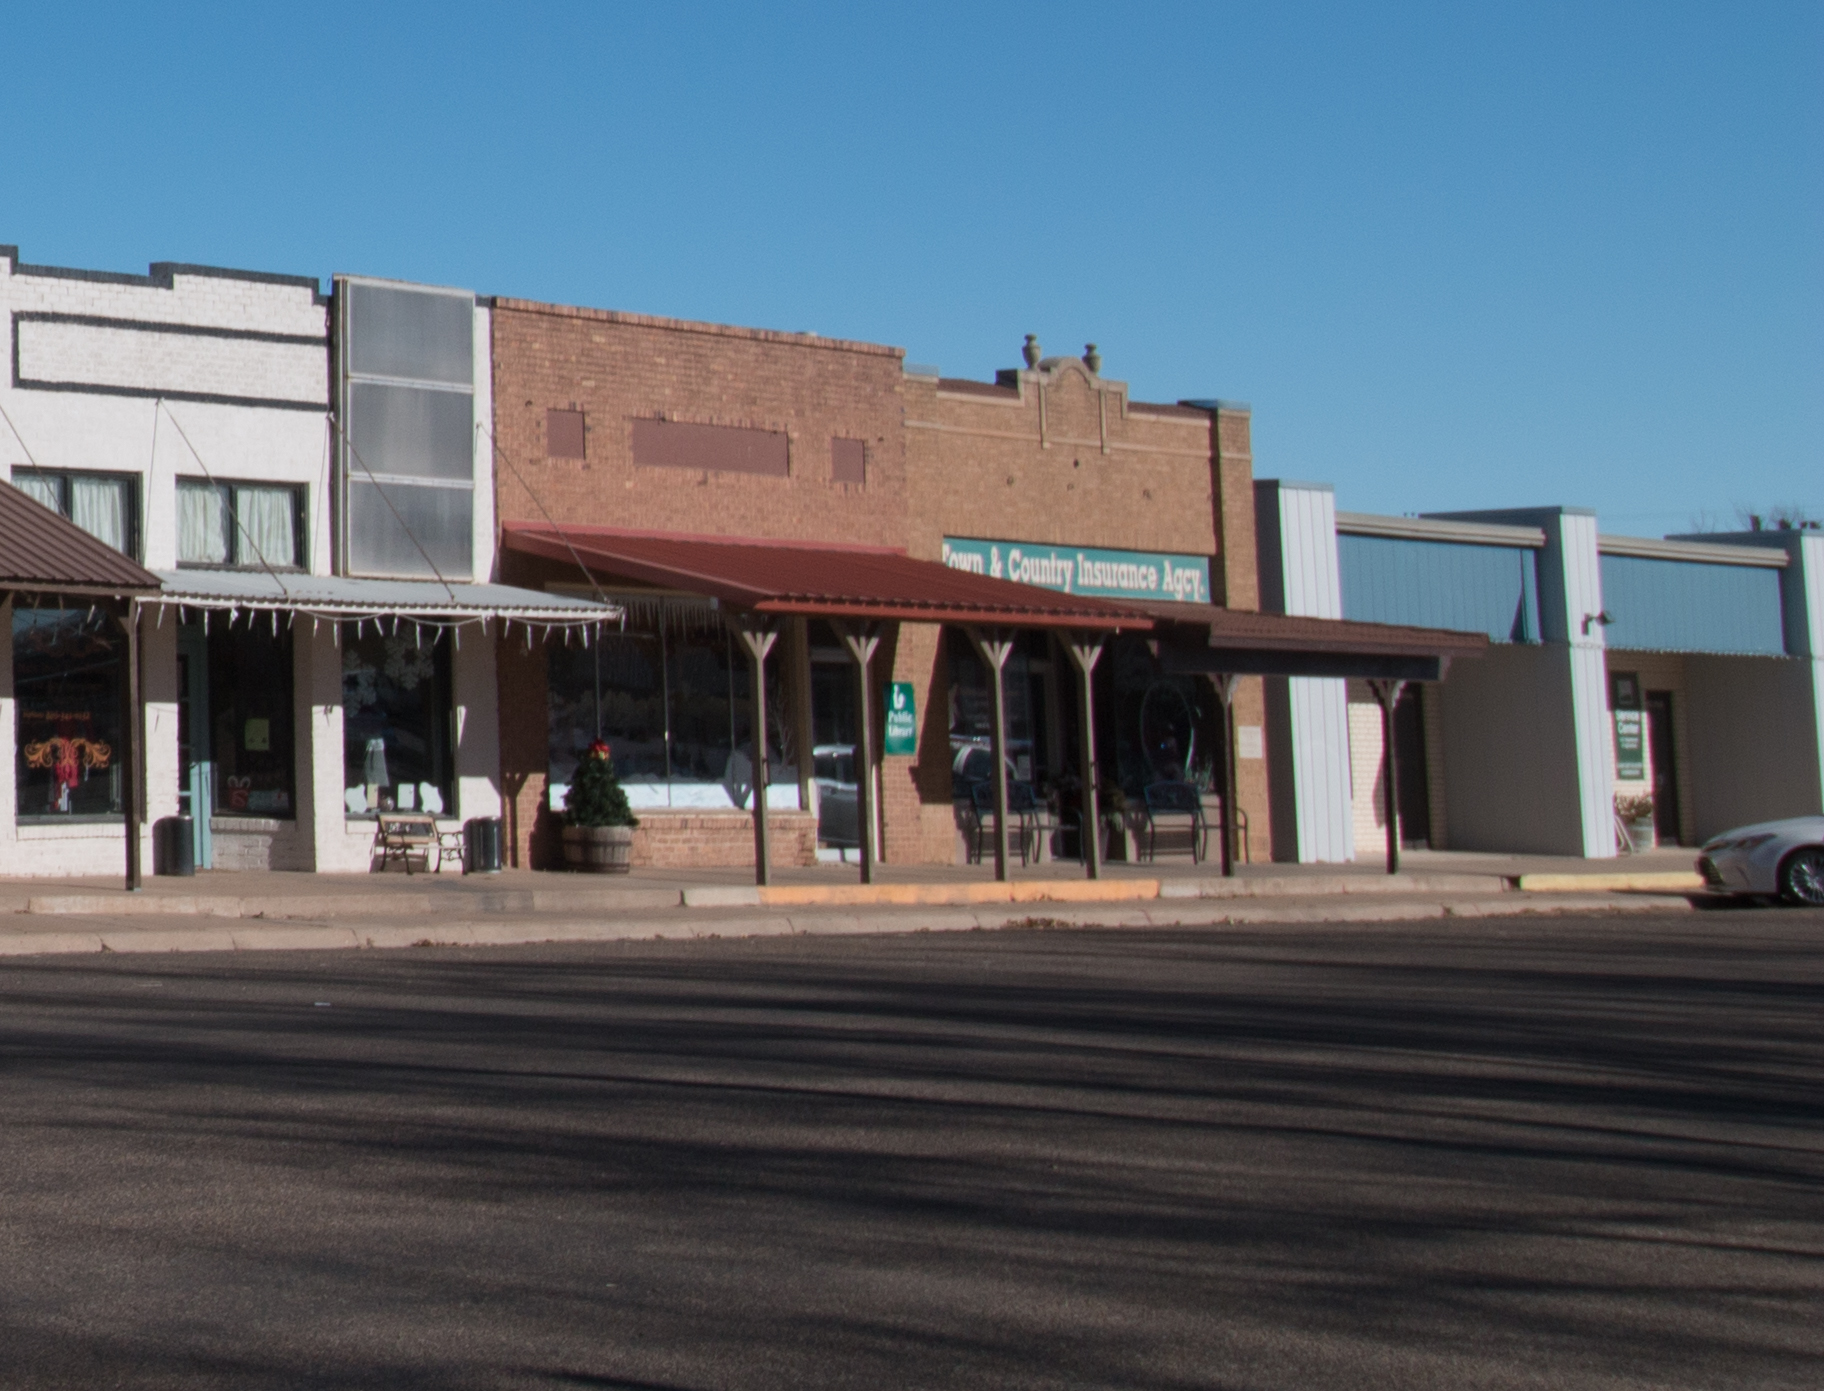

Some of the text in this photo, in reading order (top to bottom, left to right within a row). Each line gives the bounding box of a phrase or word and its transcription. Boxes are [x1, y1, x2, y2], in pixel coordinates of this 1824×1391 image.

[989, 545, 1003, 578] &
[1008, 548, 1073, 594] Country
[1077, 552, 1158, 590] Insurance
[1162, 558, 1205, 602] Agcy.
[887, 709, 913, 724] Public
[887, 724, 913, 739] Library
